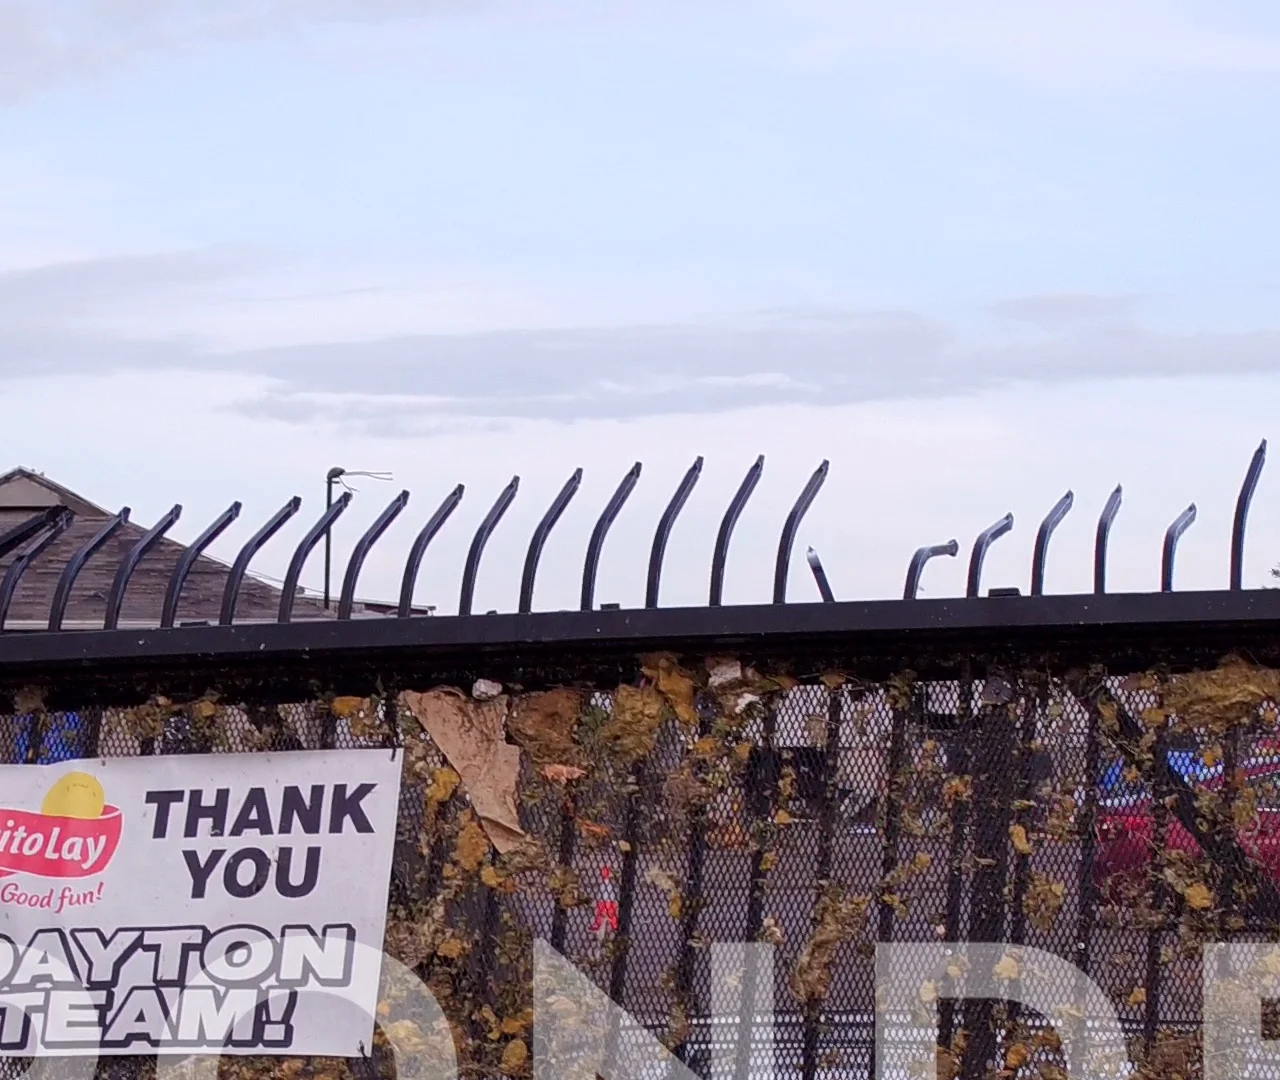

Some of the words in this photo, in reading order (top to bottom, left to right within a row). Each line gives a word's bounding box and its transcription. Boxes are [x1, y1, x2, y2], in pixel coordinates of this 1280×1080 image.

[145, 783, 378, 839] THANK
[0, 882, 54, 909] Good
[54, 881, 105, 914] fun!
[182, 846, 321, 899] YOU
